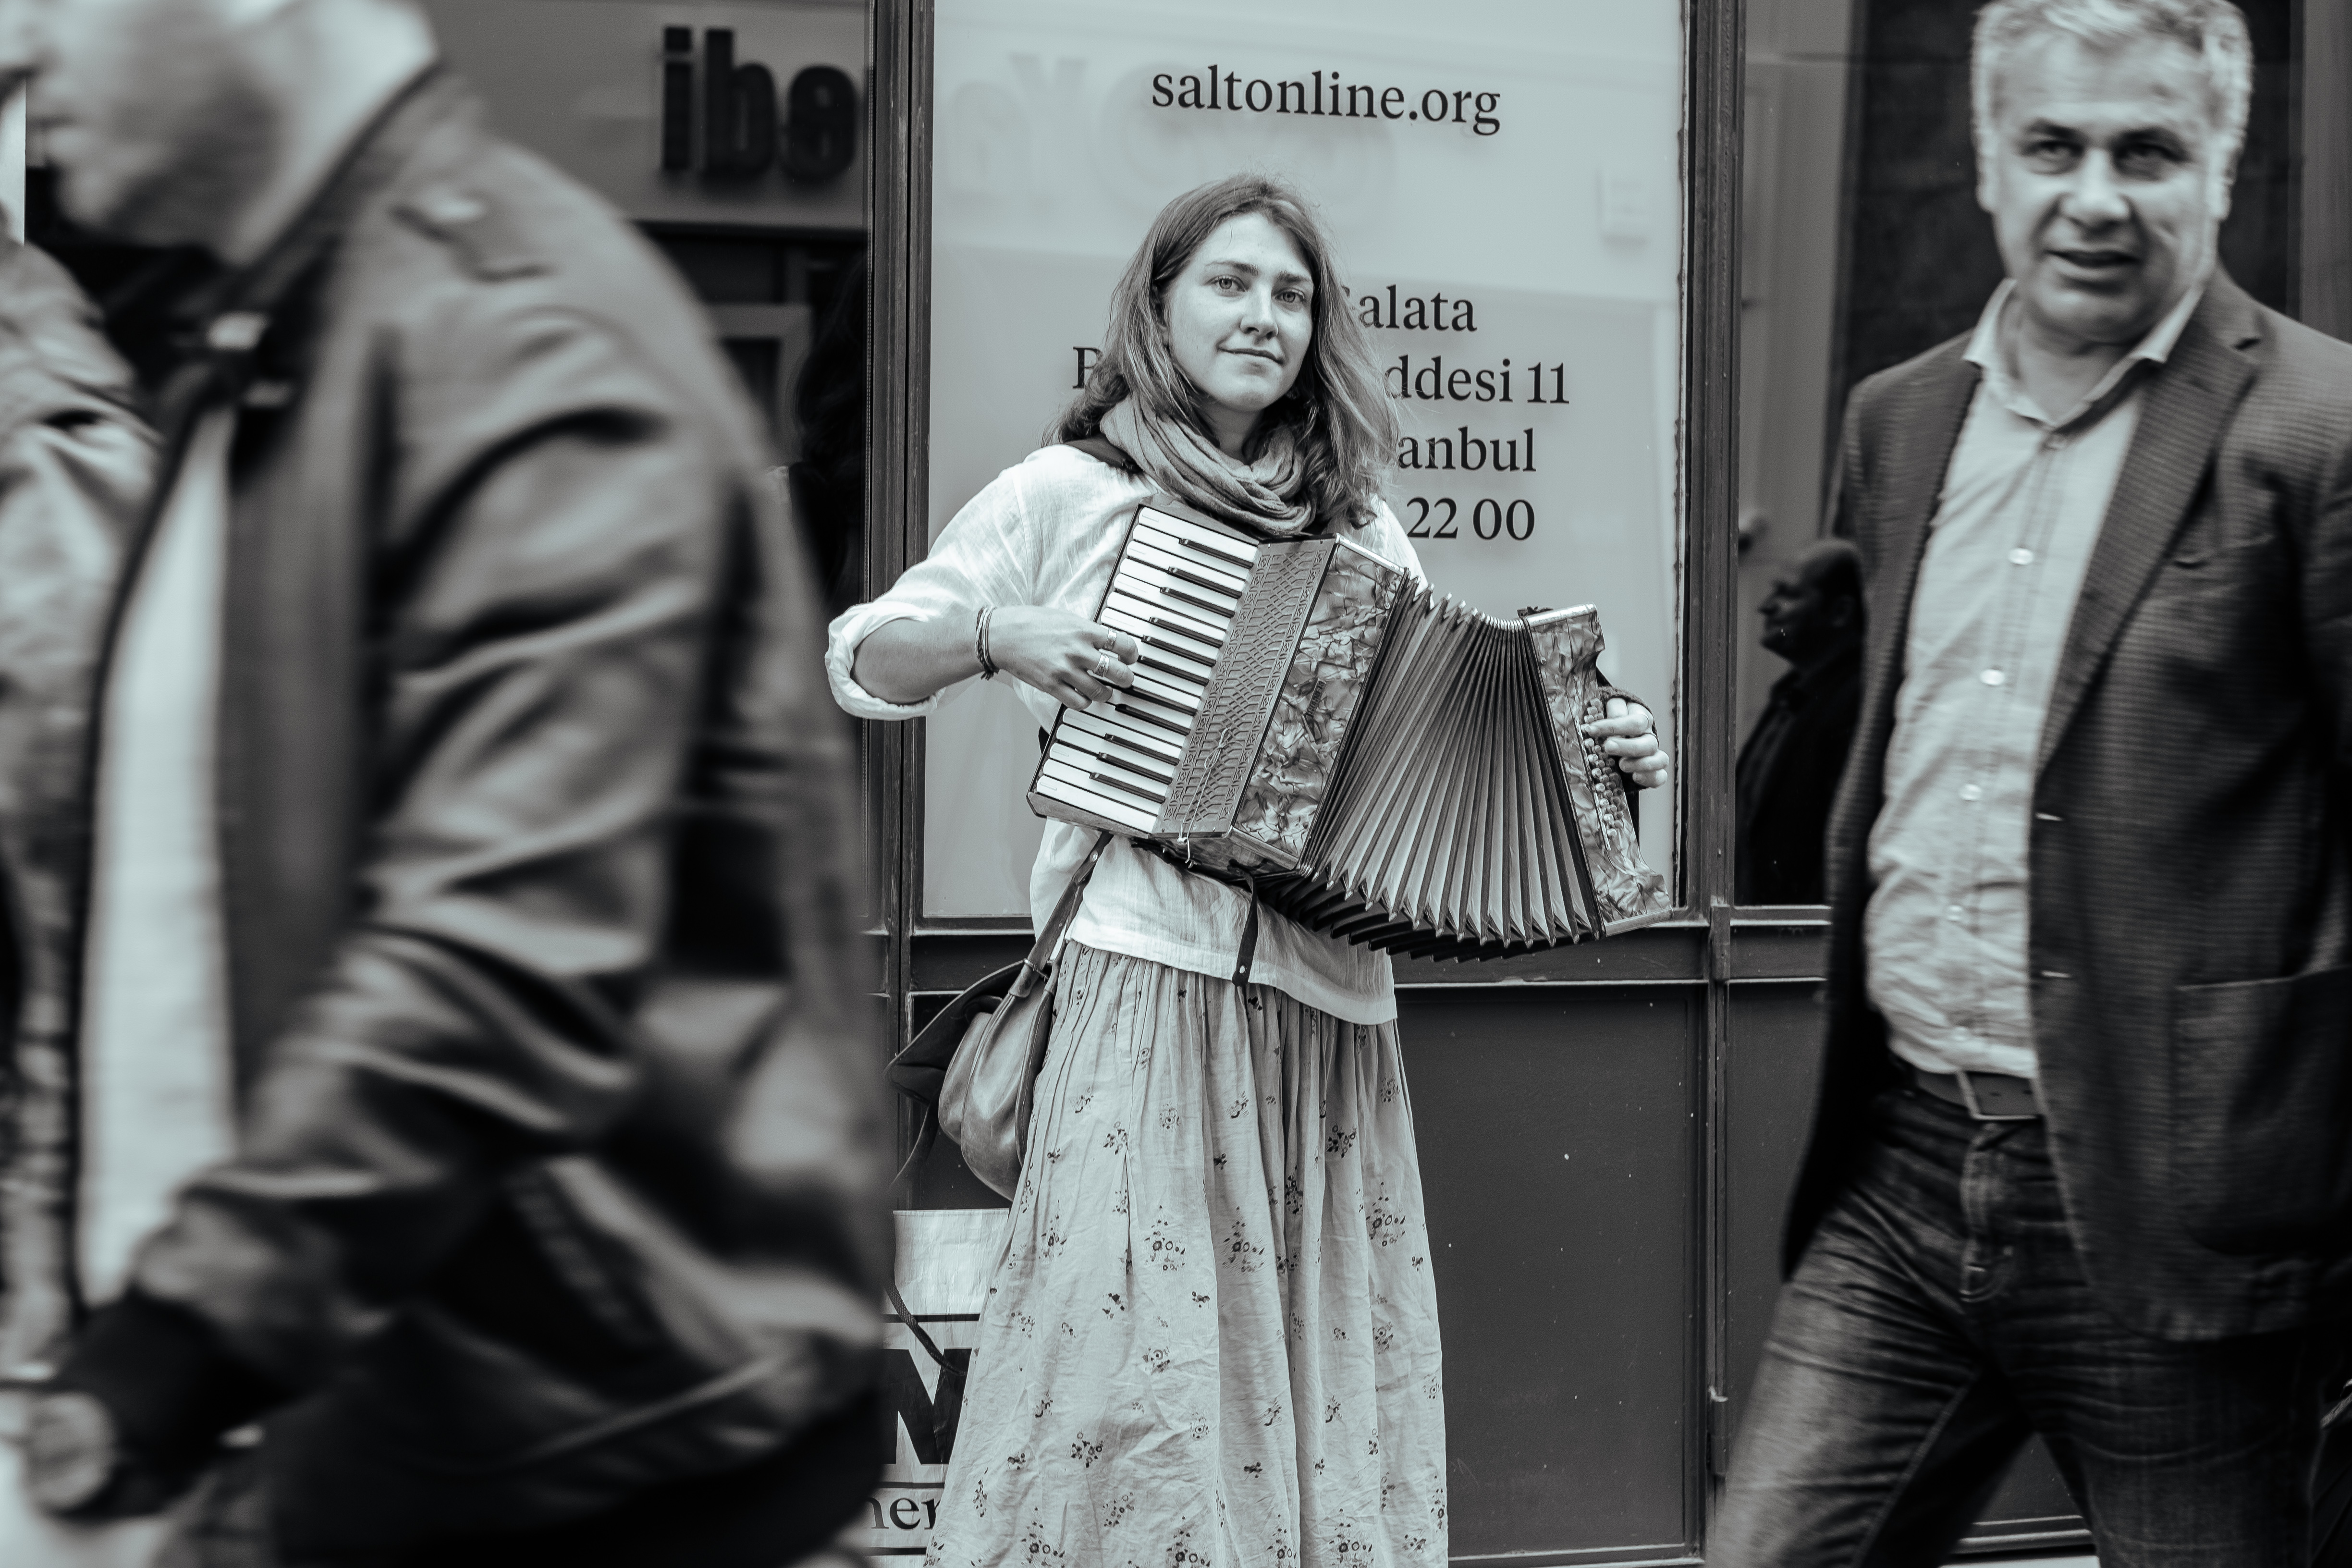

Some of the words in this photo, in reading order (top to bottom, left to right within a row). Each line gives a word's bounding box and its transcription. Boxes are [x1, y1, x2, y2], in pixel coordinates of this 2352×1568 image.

[1152, 62, 1501, 136] saltonline.org
[1341, 283, 1478, 332] alata
[1527, 361, 1570, 404] 11
[1398, 425, 1536, 473] anbul
[1406, 497, 1458, 539] 22
[1472, 498, 1535, 540] 00
